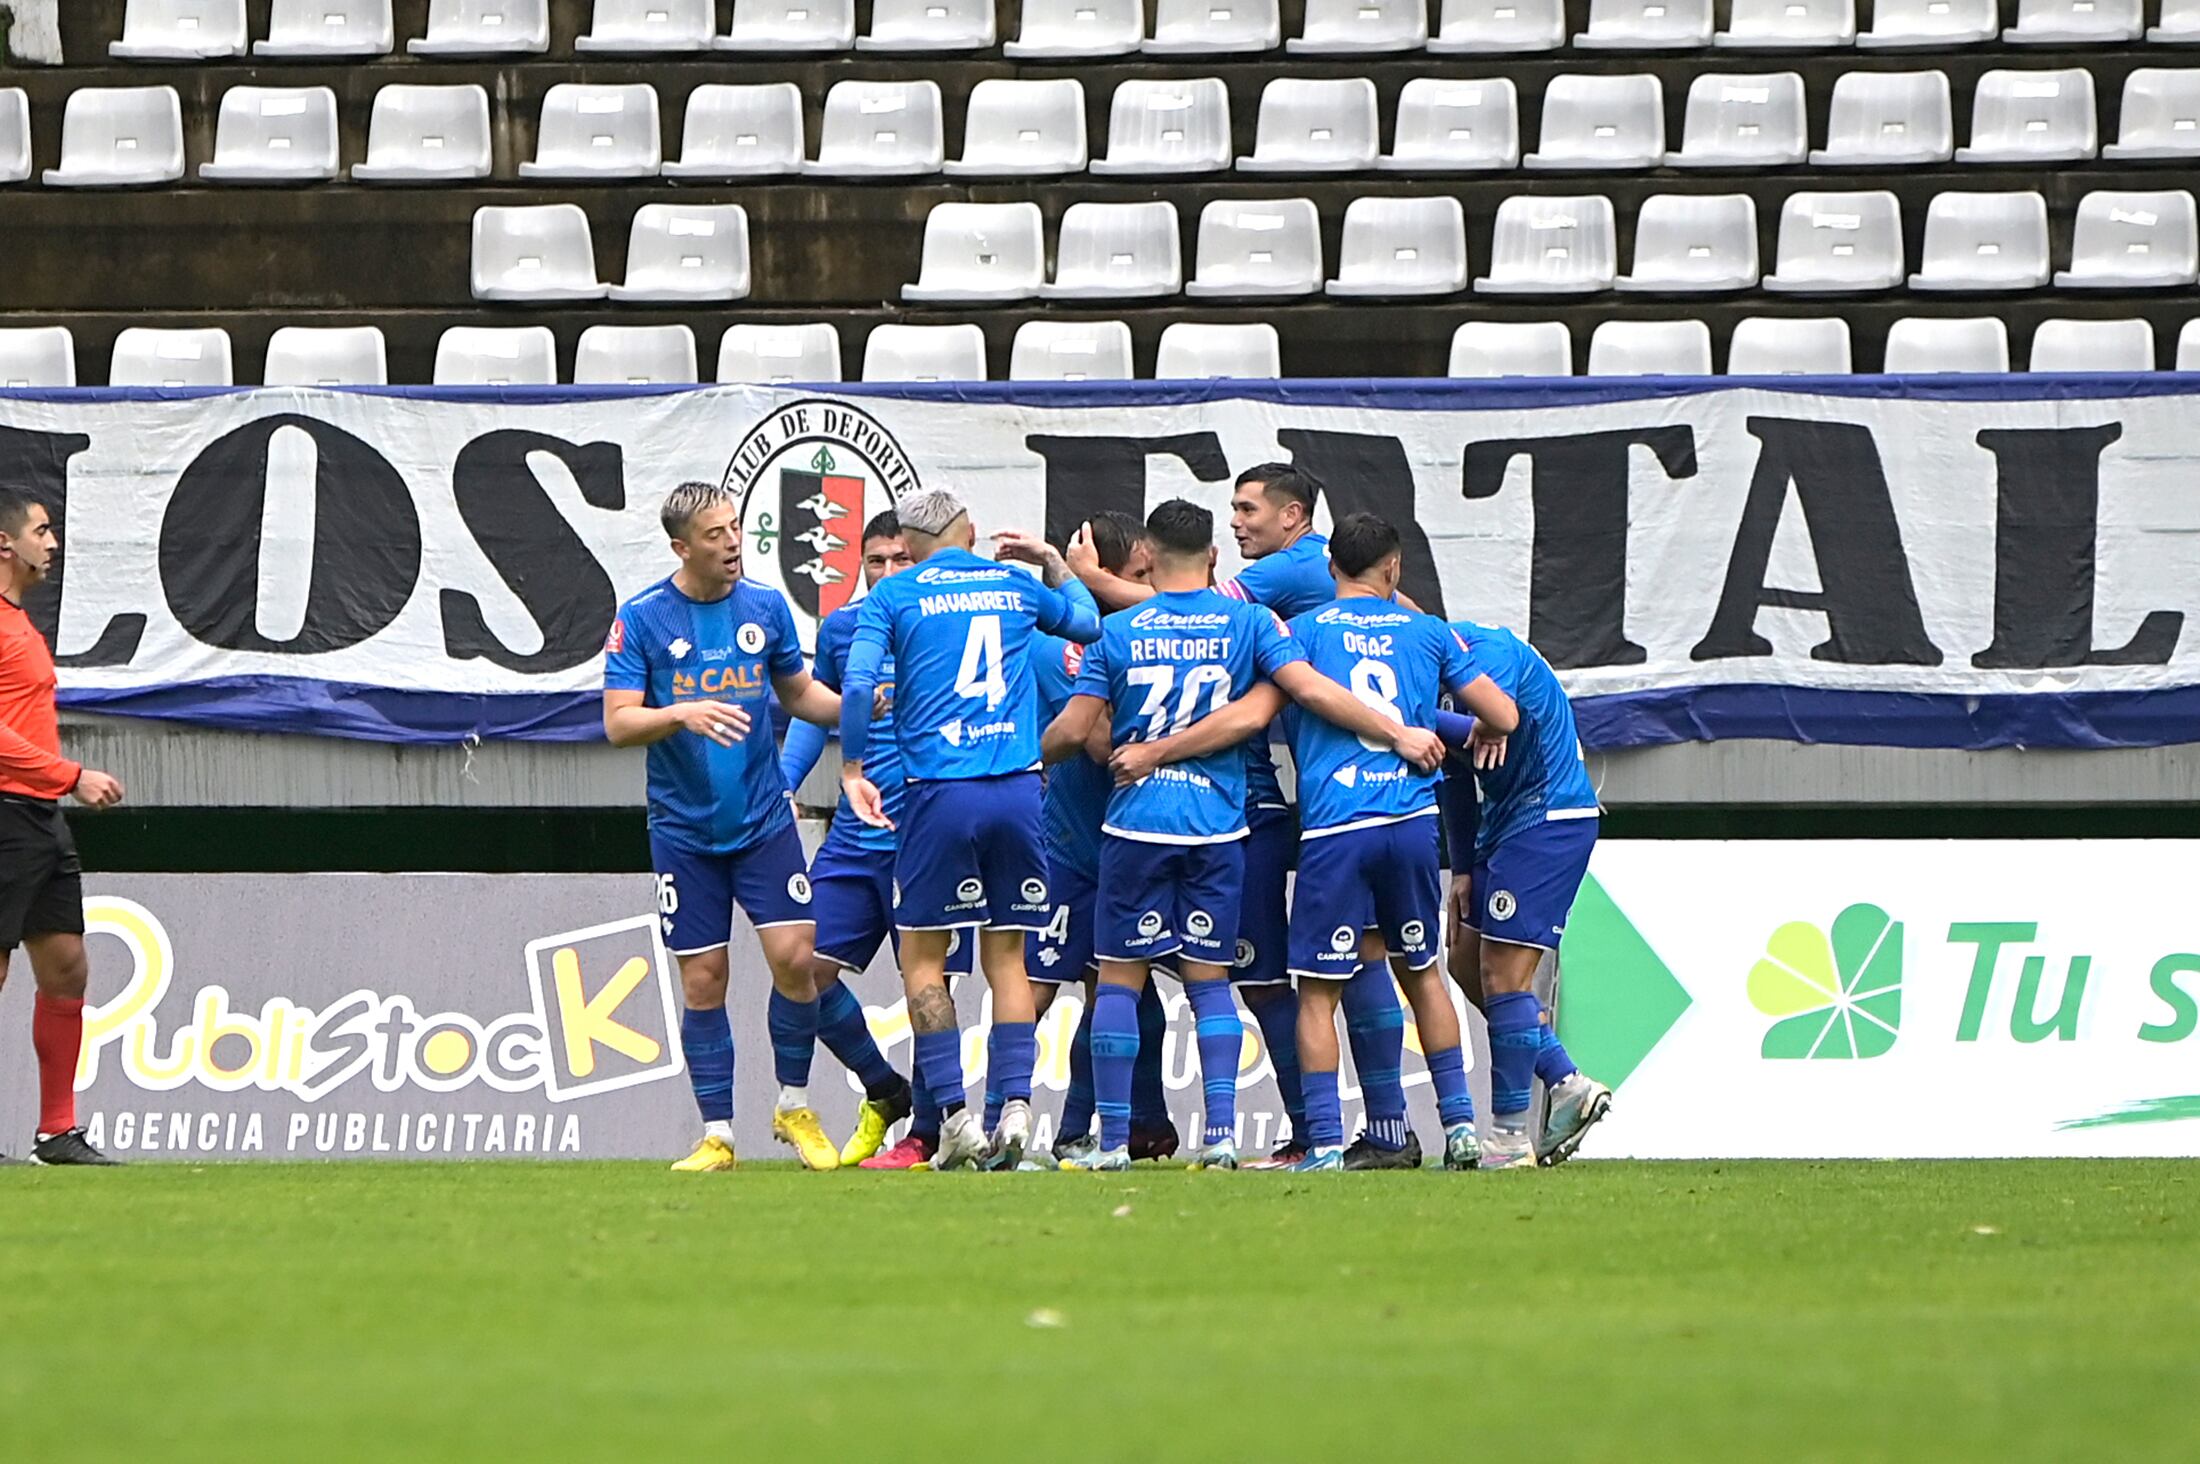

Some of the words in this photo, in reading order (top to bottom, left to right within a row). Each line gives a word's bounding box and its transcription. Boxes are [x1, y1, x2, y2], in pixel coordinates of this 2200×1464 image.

[726, 432, 772, 497] CLUB
[779, 408, 811, 439] DE
[918, 591, 1025, 617] NAVARRETE
[1130, 607, 1231, 628] Carmen
[1315, 607, 1412, 624] Carmen
[953, 614, 1006, 712] 4
[1130, 637, 1232, 662] RENCORET
[1946, 921, 2092, 1044] Tu
[87, 1112, 266, 1151] AGENCIA
[286, 1112, 582, 1152] PUBLICITARIA
